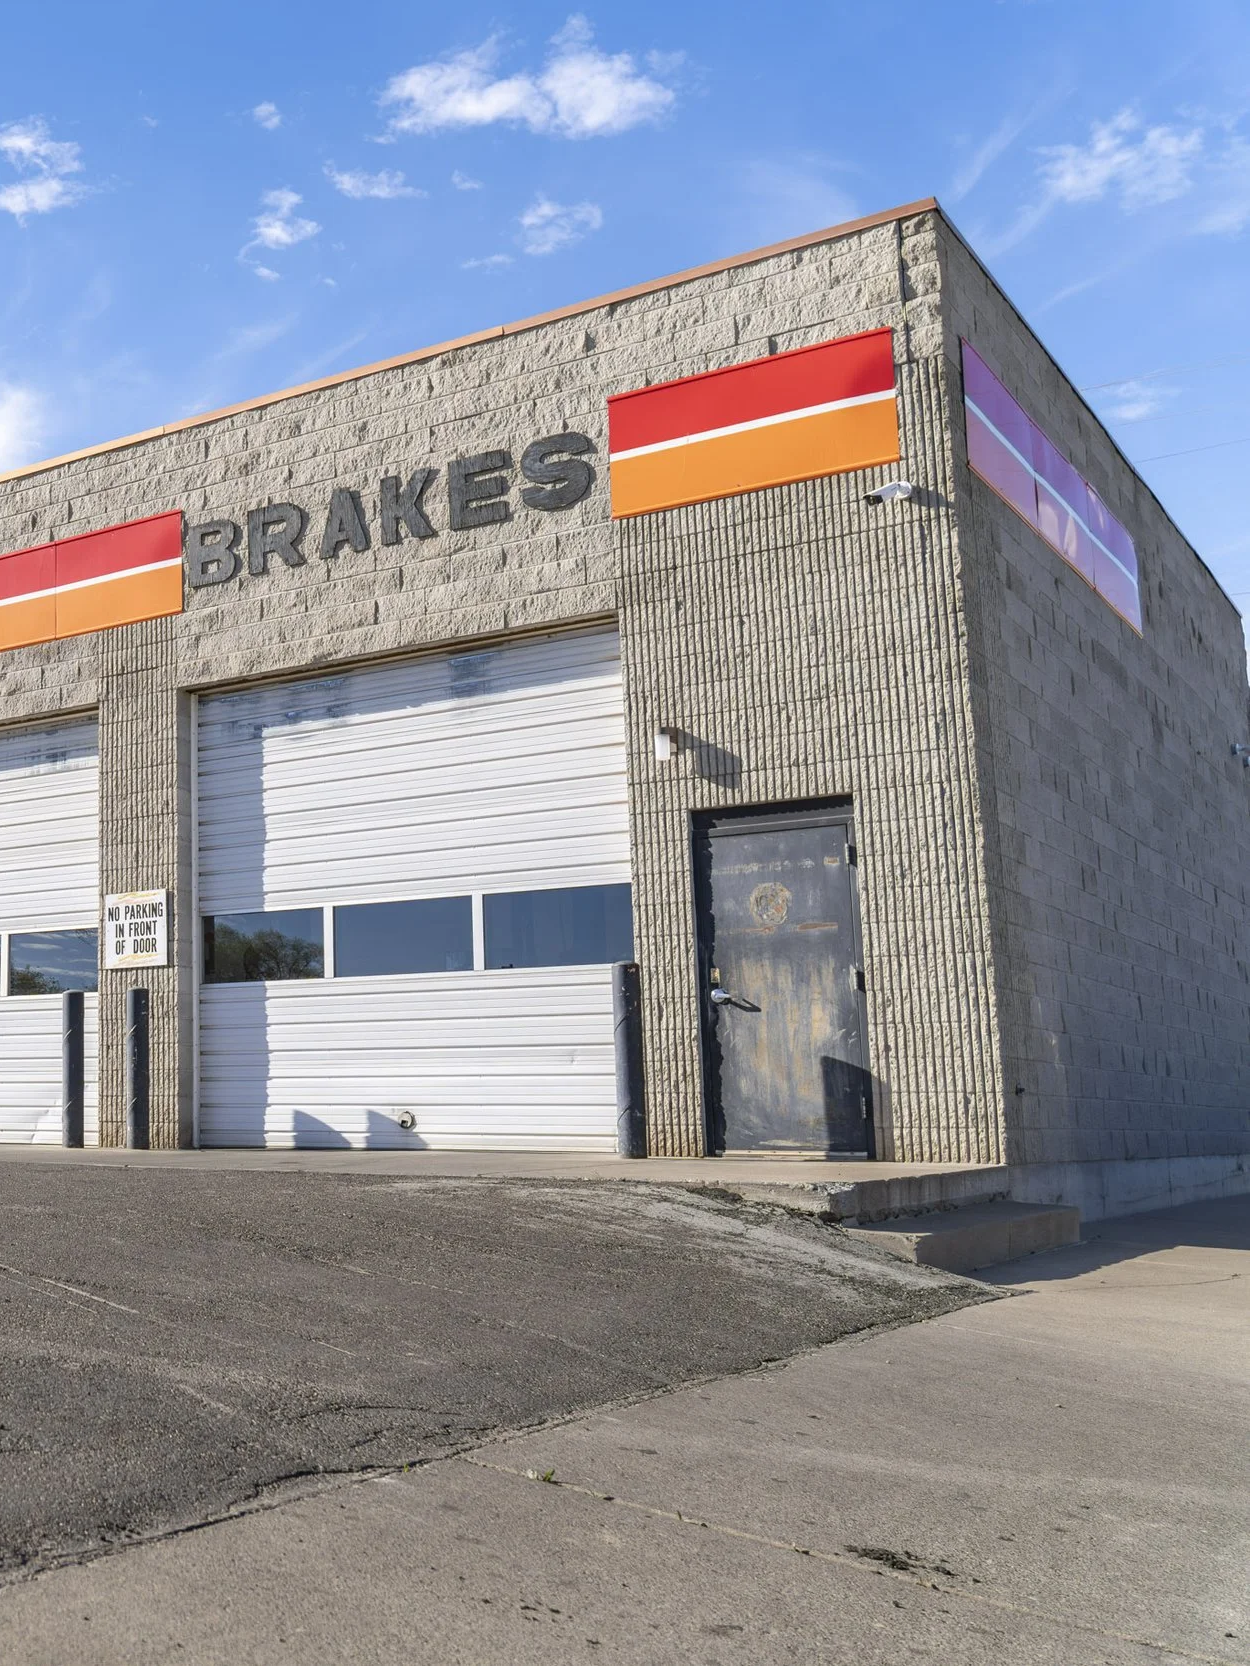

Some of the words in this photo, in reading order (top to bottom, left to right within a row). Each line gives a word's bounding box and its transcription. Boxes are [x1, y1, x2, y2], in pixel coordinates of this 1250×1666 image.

[188, 431, 593, 588] BRAKES
[107, 906, 120, 922] NO
[124, 902, 164, 921] PARKING
[115, 923, 125, 939] IN
[128, 920, 158, 937] FRONT
[115, 940, 126, 956] OF
[133, 938, 157, 954] DOOR
